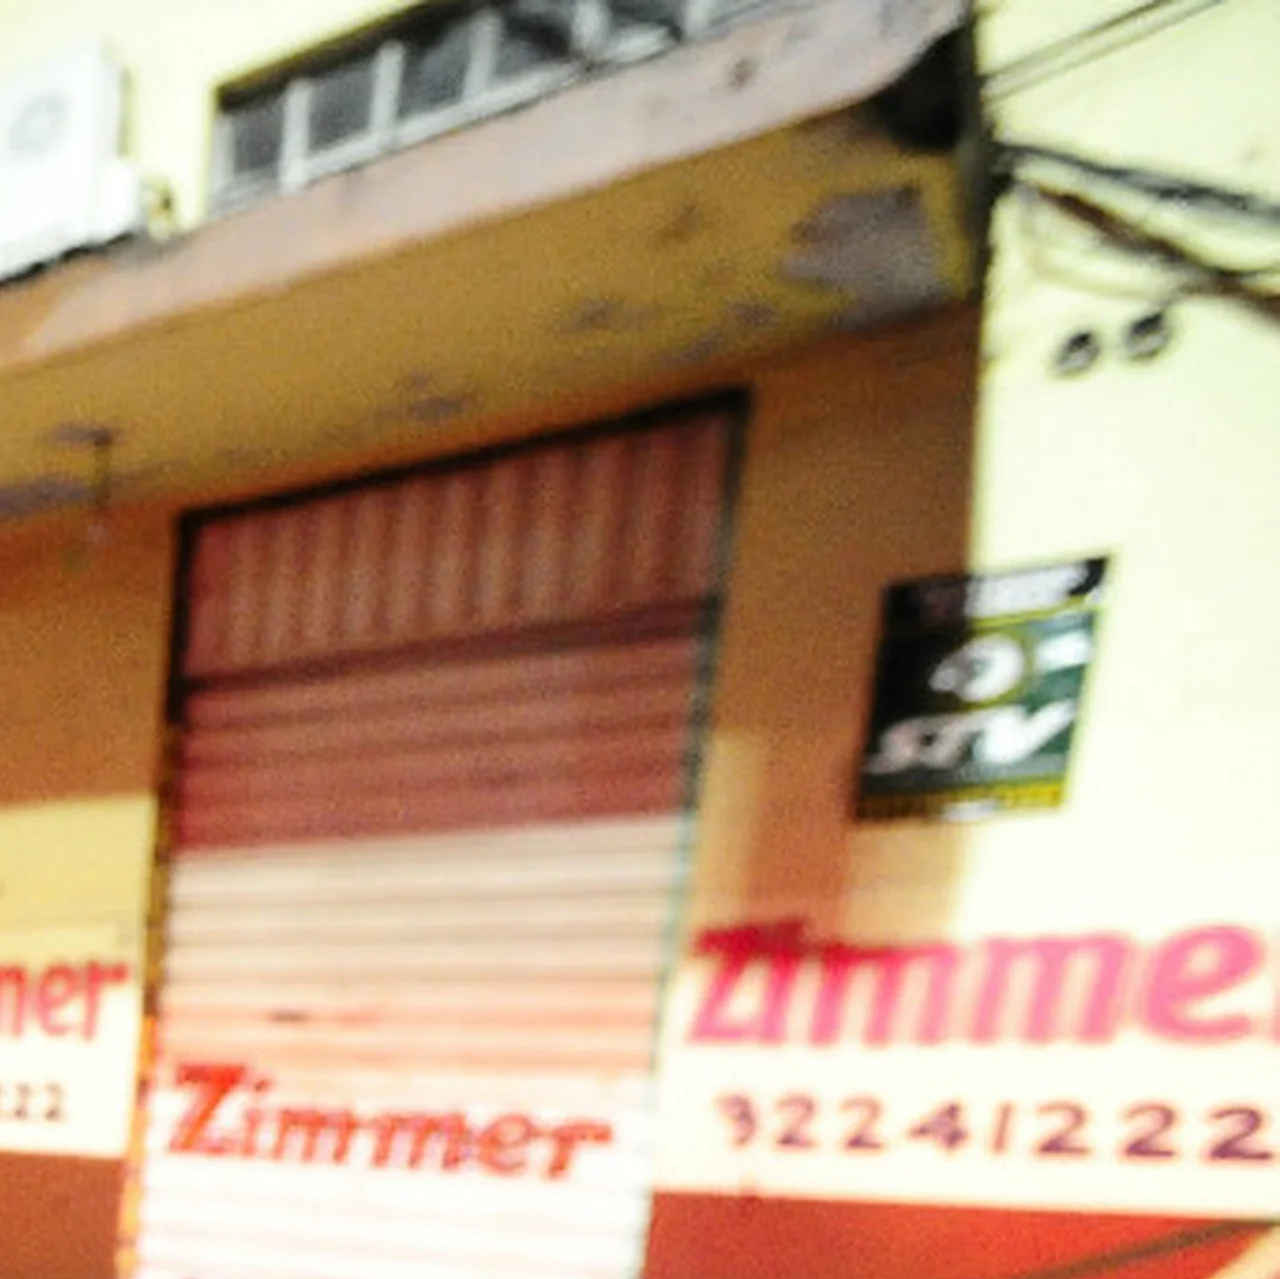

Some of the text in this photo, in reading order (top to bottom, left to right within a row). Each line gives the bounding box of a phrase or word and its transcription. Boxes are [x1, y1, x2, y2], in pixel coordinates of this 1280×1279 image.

[687, 920, 1280, 1046] Zimme
[169, 1062, 614, 1180] Zimmer
[716, 1095, 1274, 1161] 32241222
